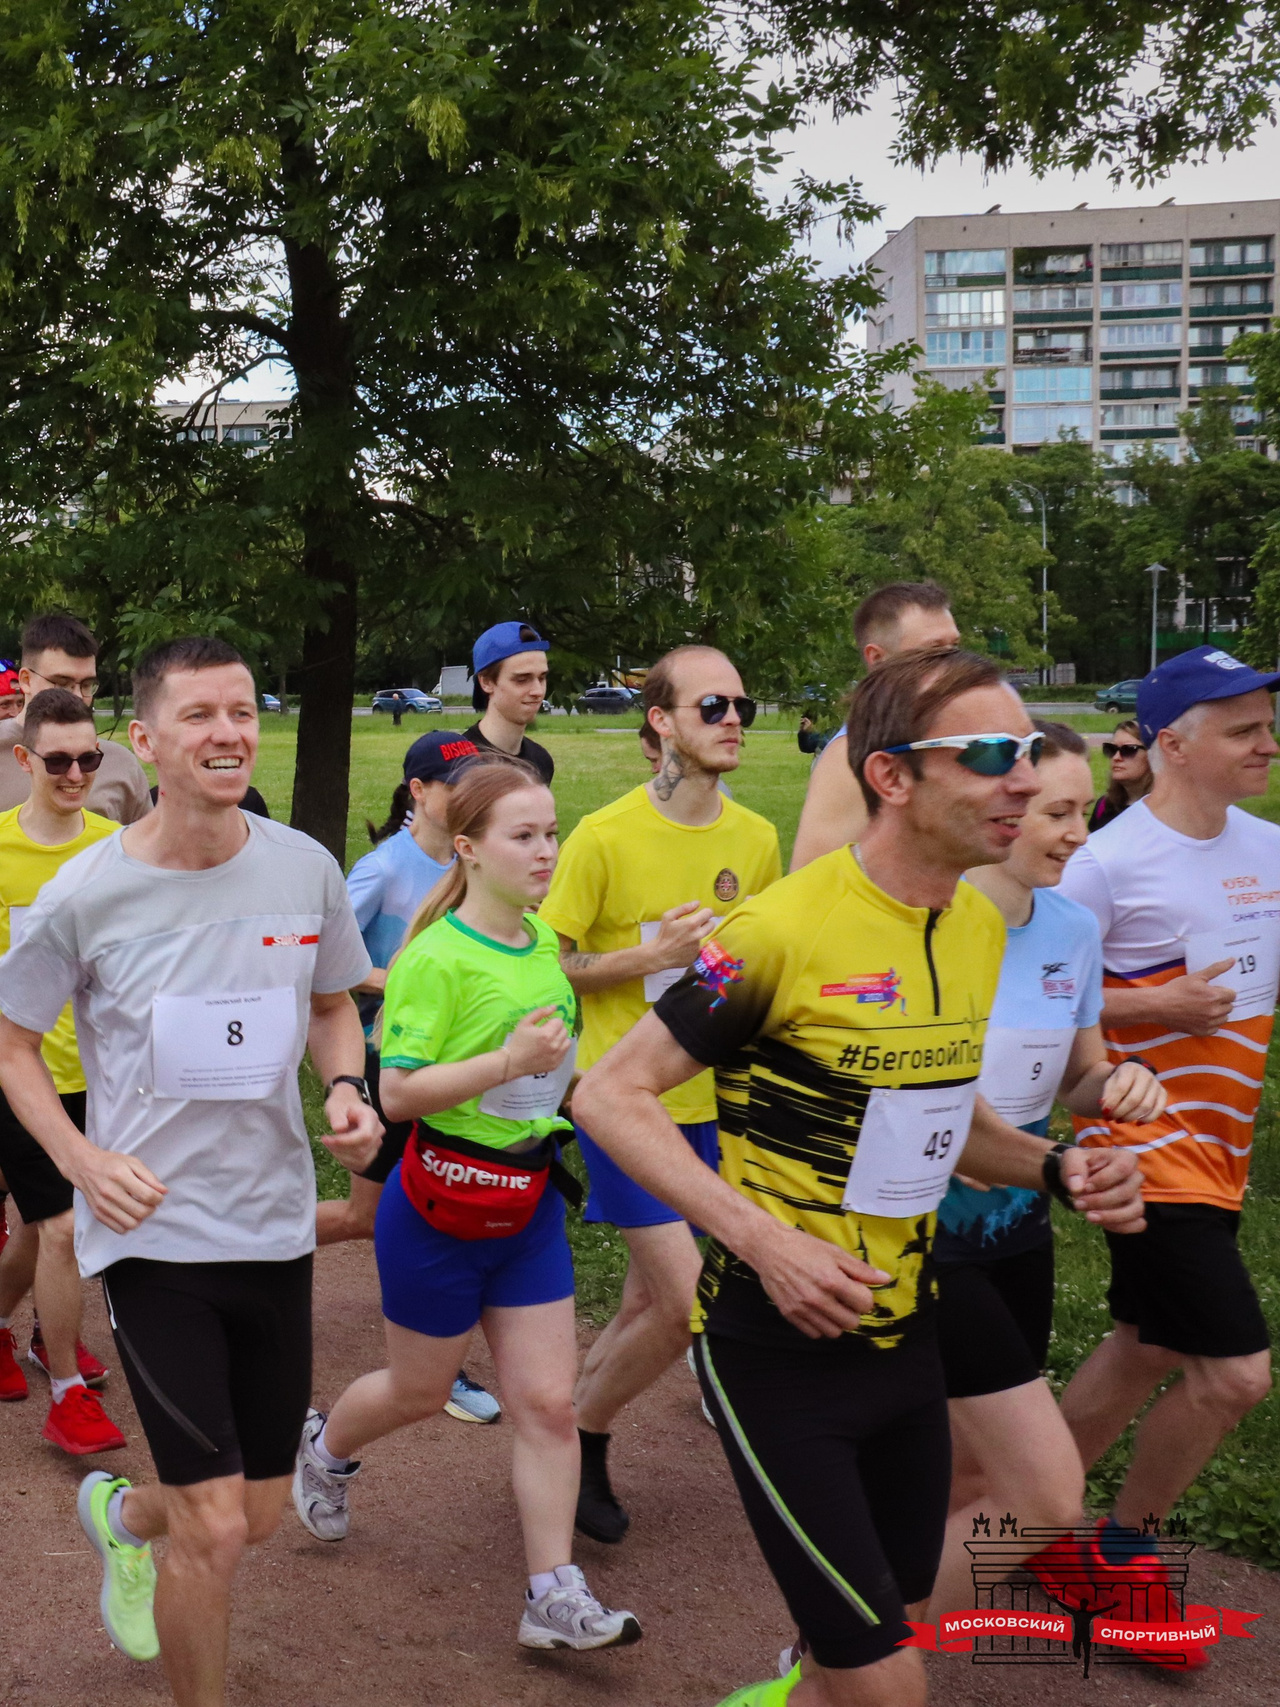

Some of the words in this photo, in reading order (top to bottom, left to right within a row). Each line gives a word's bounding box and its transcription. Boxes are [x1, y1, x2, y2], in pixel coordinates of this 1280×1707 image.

[1238, 954, 1256, 975] 19
[227, 1020, 244, 1046] 8
[1031, 1061, 1042, 1081] 9
[923, 1129, 952, 1161] 49
[421, 1149, 531, 1190] Supreme
